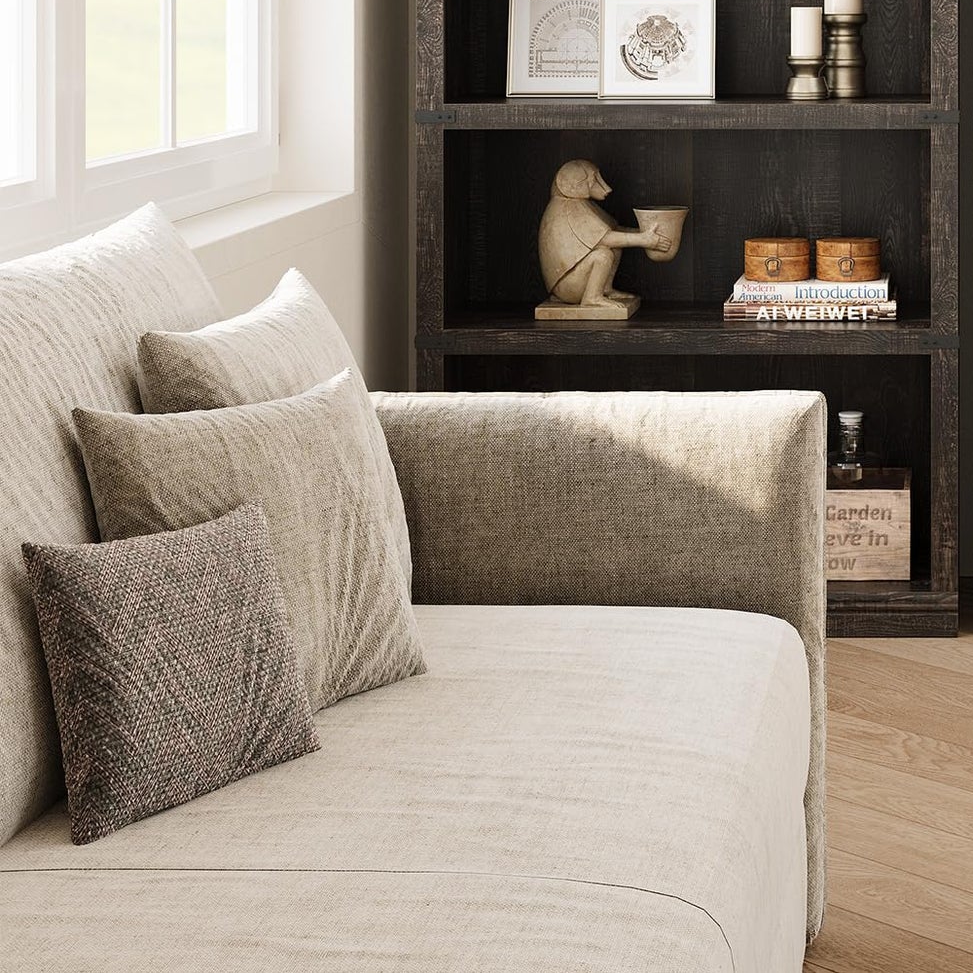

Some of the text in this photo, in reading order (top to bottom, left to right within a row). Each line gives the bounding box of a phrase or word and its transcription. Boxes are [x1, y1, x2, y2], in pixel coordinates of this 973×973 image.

[741, 284, 775, 292] Modern
[795, 285, 886, 299] Introduction
[739, 292, 783, 301] American
[756, 305, 869, 320] AI WEIWEI
[825, 504, 892, 521] Garden
[868, 530, 889, 546] in
